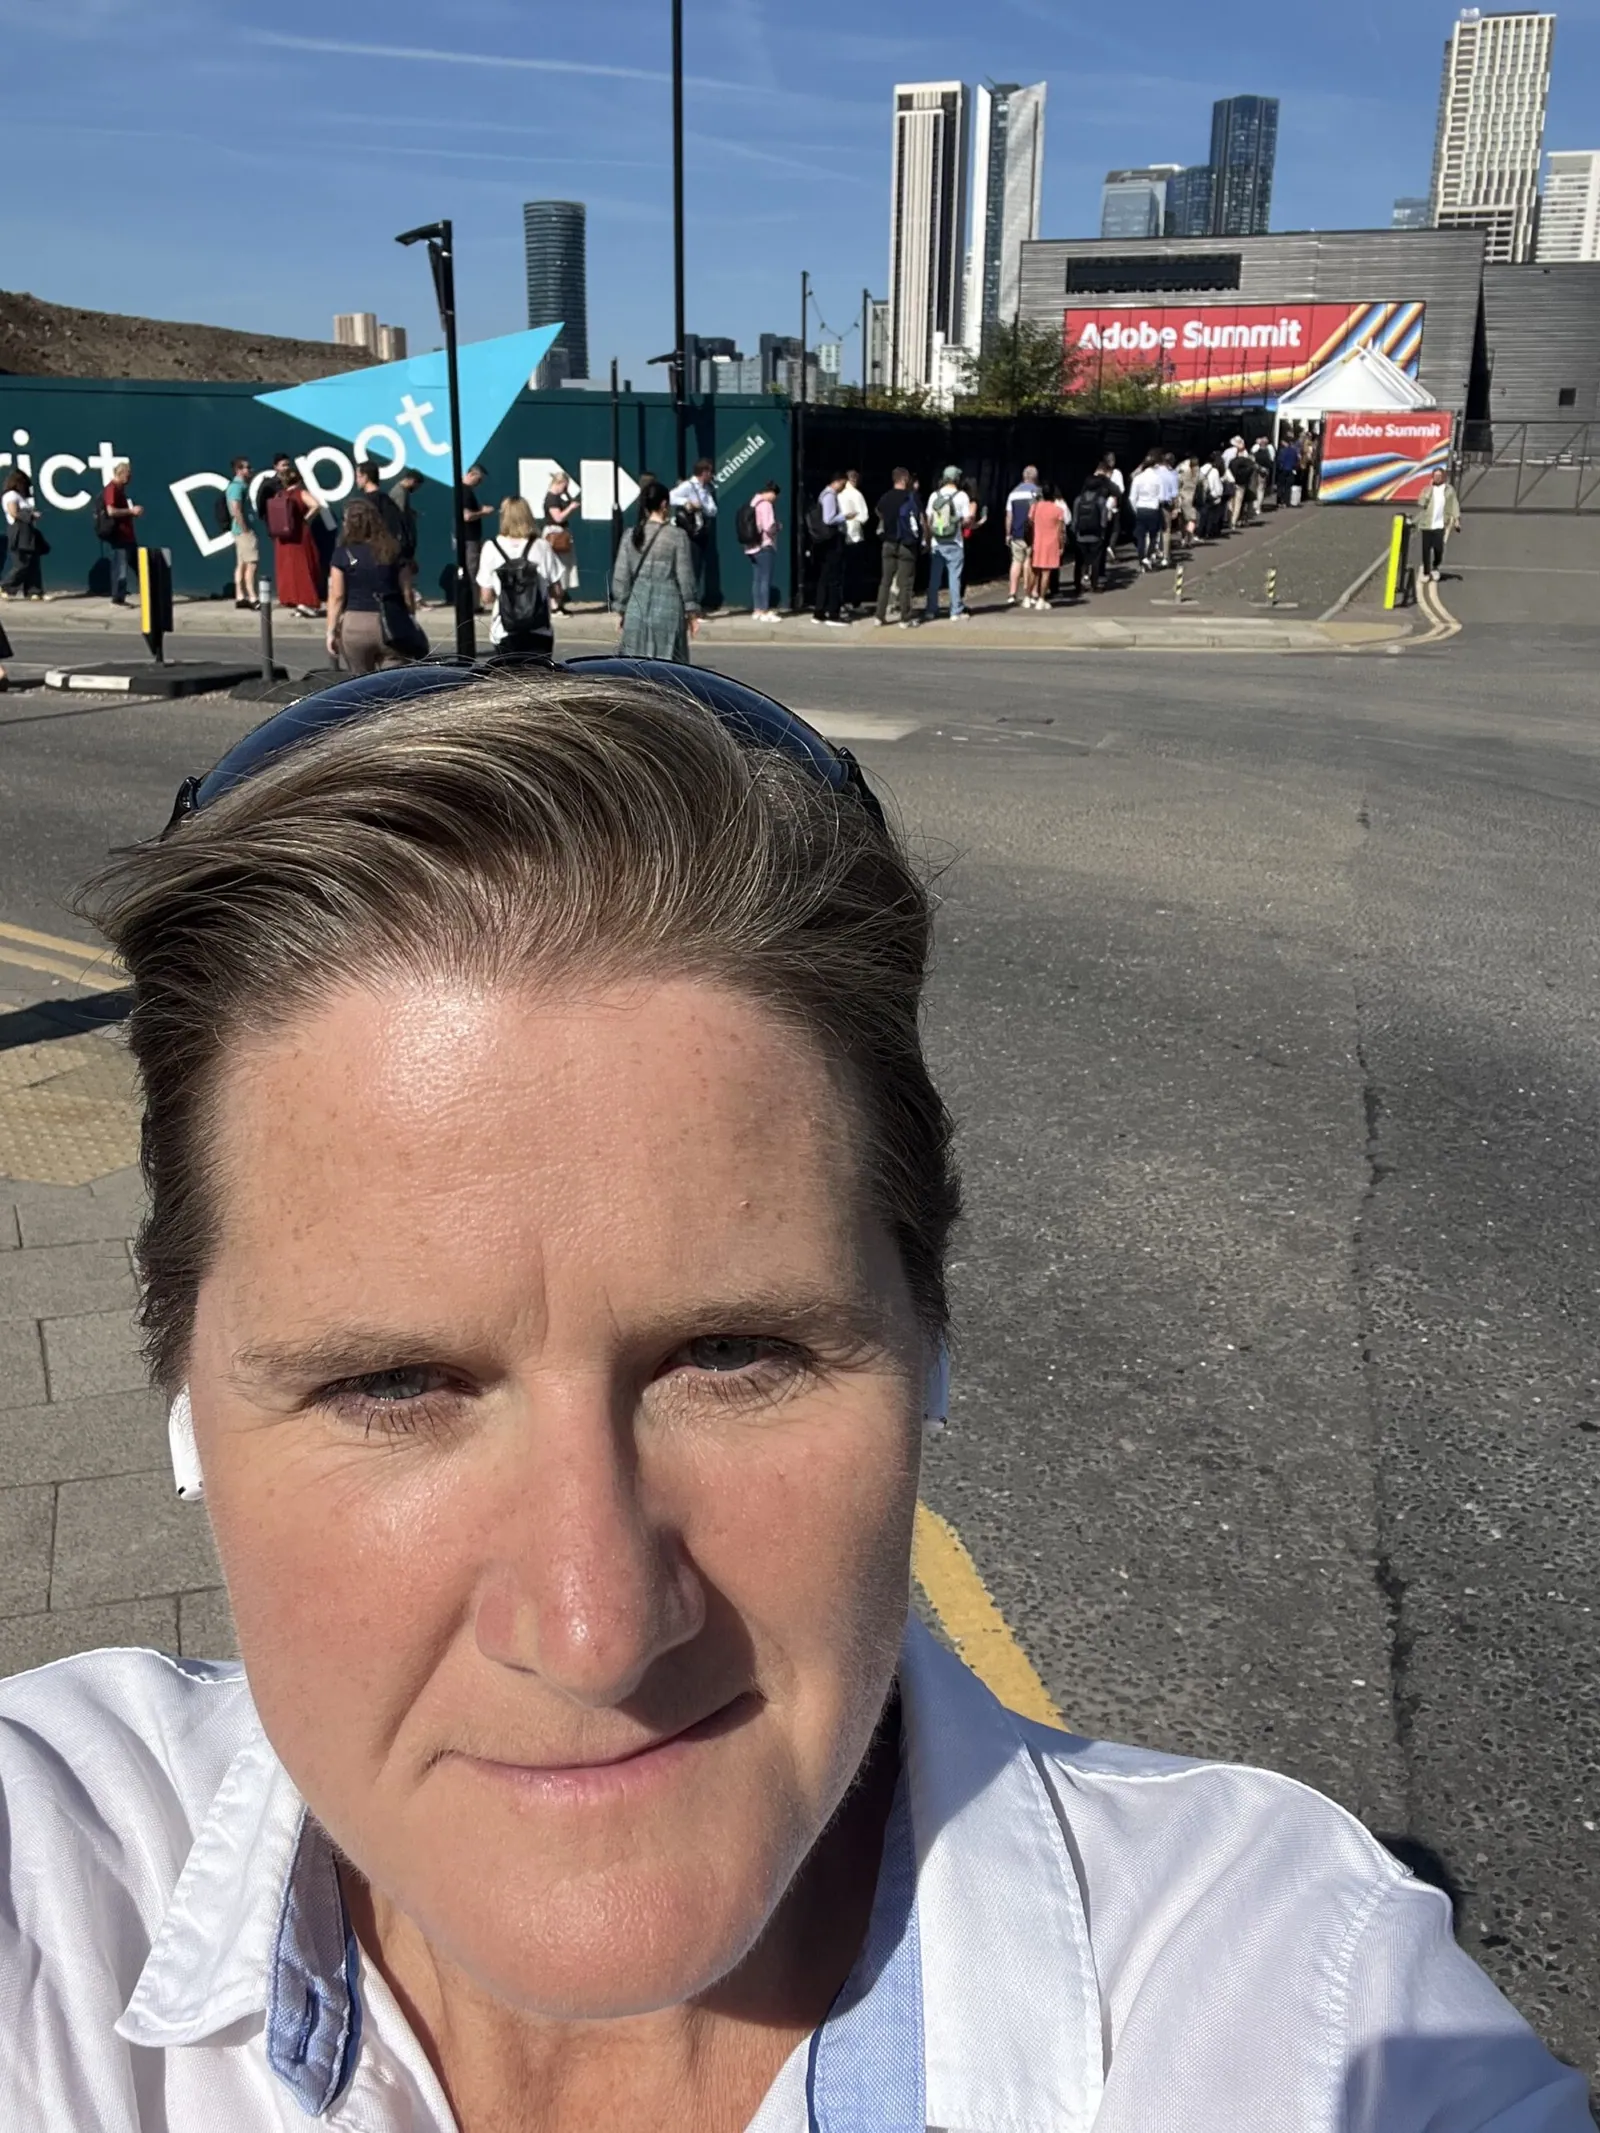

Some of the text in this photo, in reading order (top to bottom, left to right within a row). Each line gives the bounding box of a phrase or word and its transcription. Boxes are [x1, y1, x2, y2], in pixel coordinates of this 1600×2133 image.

[1079, 318, 1302, 350] Adobe Summit
[1334, 422, 1441, 437] Adobe Summit
